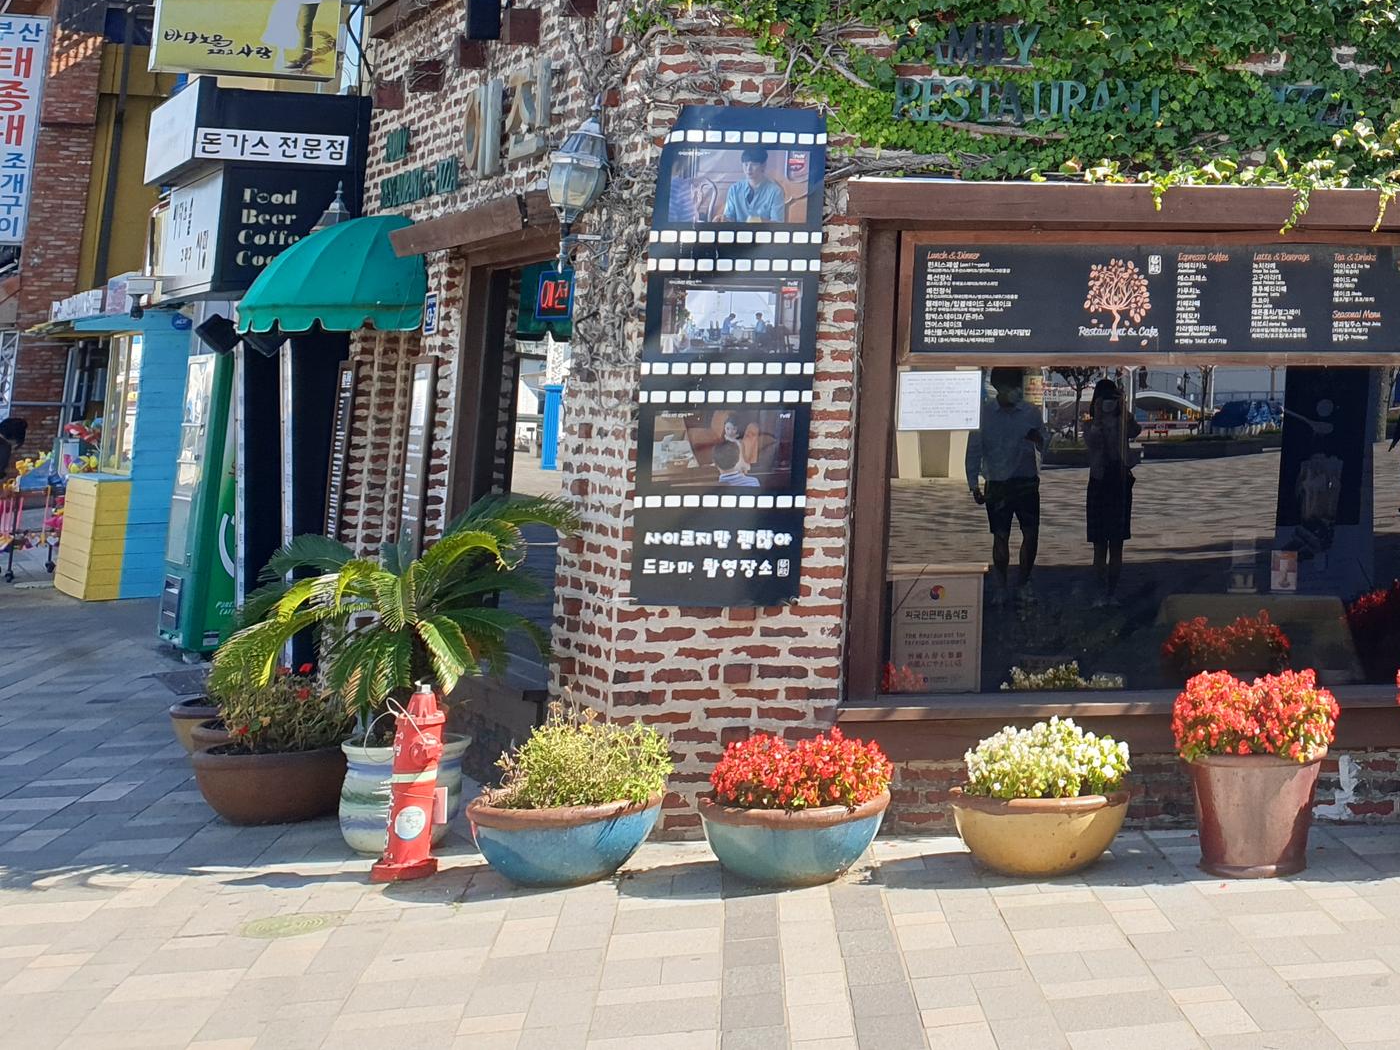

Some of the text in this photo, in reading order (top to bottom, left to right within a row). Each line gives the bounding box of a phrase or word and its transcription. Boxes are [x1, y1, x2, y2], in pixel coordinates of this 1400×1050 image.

[201, 132, 345, 161] 돈가스 전문점
[0, 152, 27, 238] 조개구이
[242, 188, 298, 205] Food
[241, 209, 297, 225] Beer
[927, 251, 948, 260] Lunch
[1177, 252, 1229, 262] Espresso Coffee
[1253, 252, 1310, 263] Latte & Beverage
[1334, 253, 1348, 261] Tea
[1354, 253, 1377, 261] Drinks
[1332, 310, 1381, 320] Seasonal Menu
[1078, 326, 1127, 337] Restaurnt
[1139, 326, 1159, 337] Cafe
[643, 529, 793, 550] 사이코지만 괜찮아
[642, 558, 695, 576] 드라마
[702, 557, 773, 578] 촬영장소
